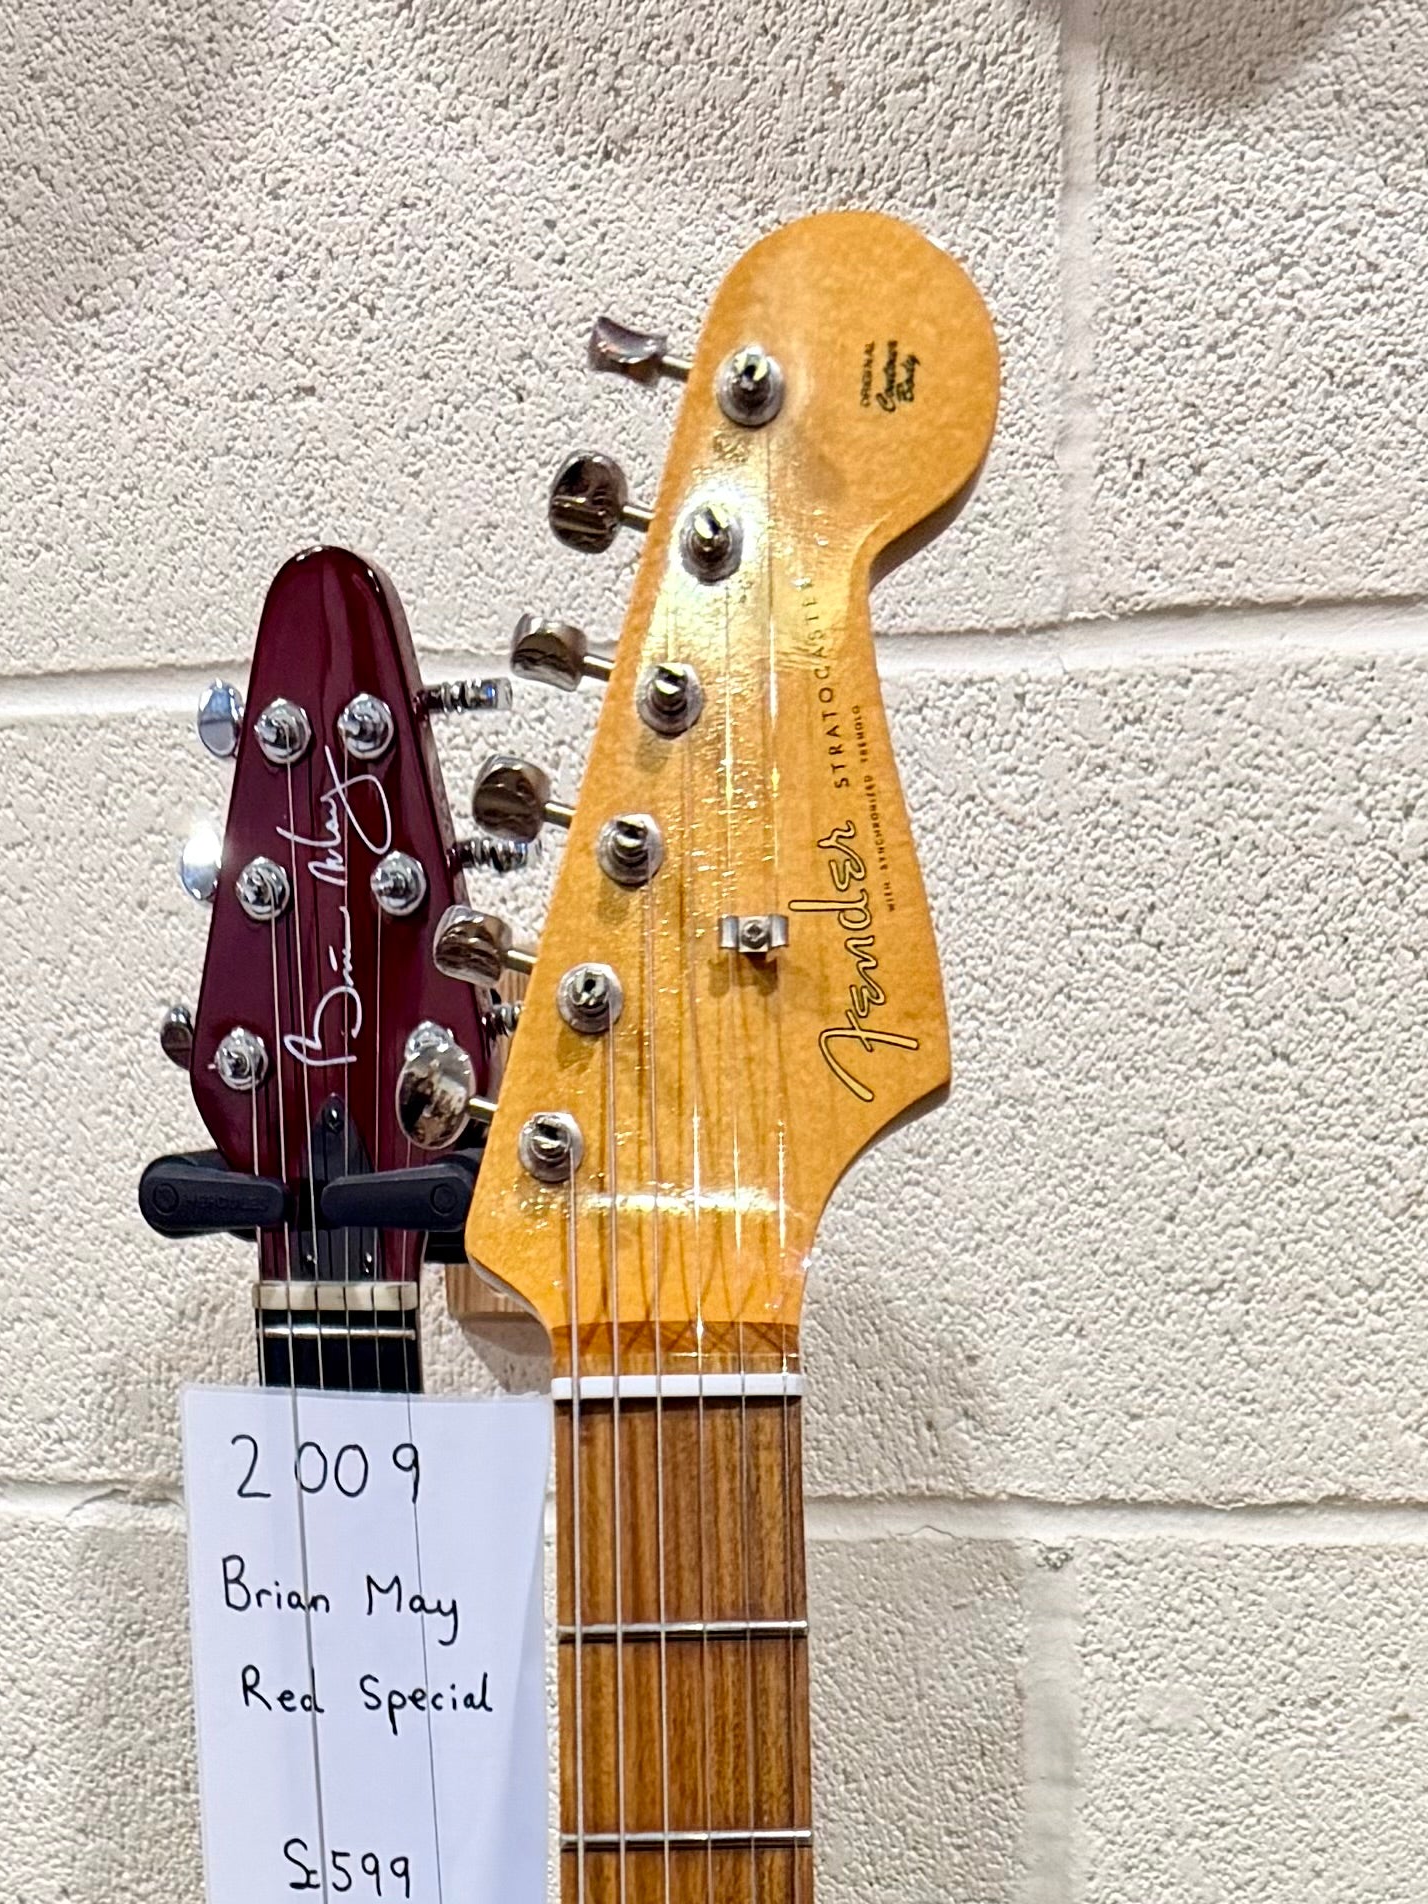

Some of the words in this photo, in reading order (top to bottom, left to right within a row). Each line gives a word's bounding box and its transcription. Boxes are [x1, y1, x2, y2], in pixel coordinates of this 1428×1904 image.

[788, 820, 920, 1103] Fender
[232, 1434, 422, 1504] 2009
[223, 1555, 330, 1614] Brian
[367, 1575, 461, 1645] May
[242, 1665, 324, 1714] Red
[360, 1673, 496, 1735] Special
[283, 1838, 414, 1899] £599
